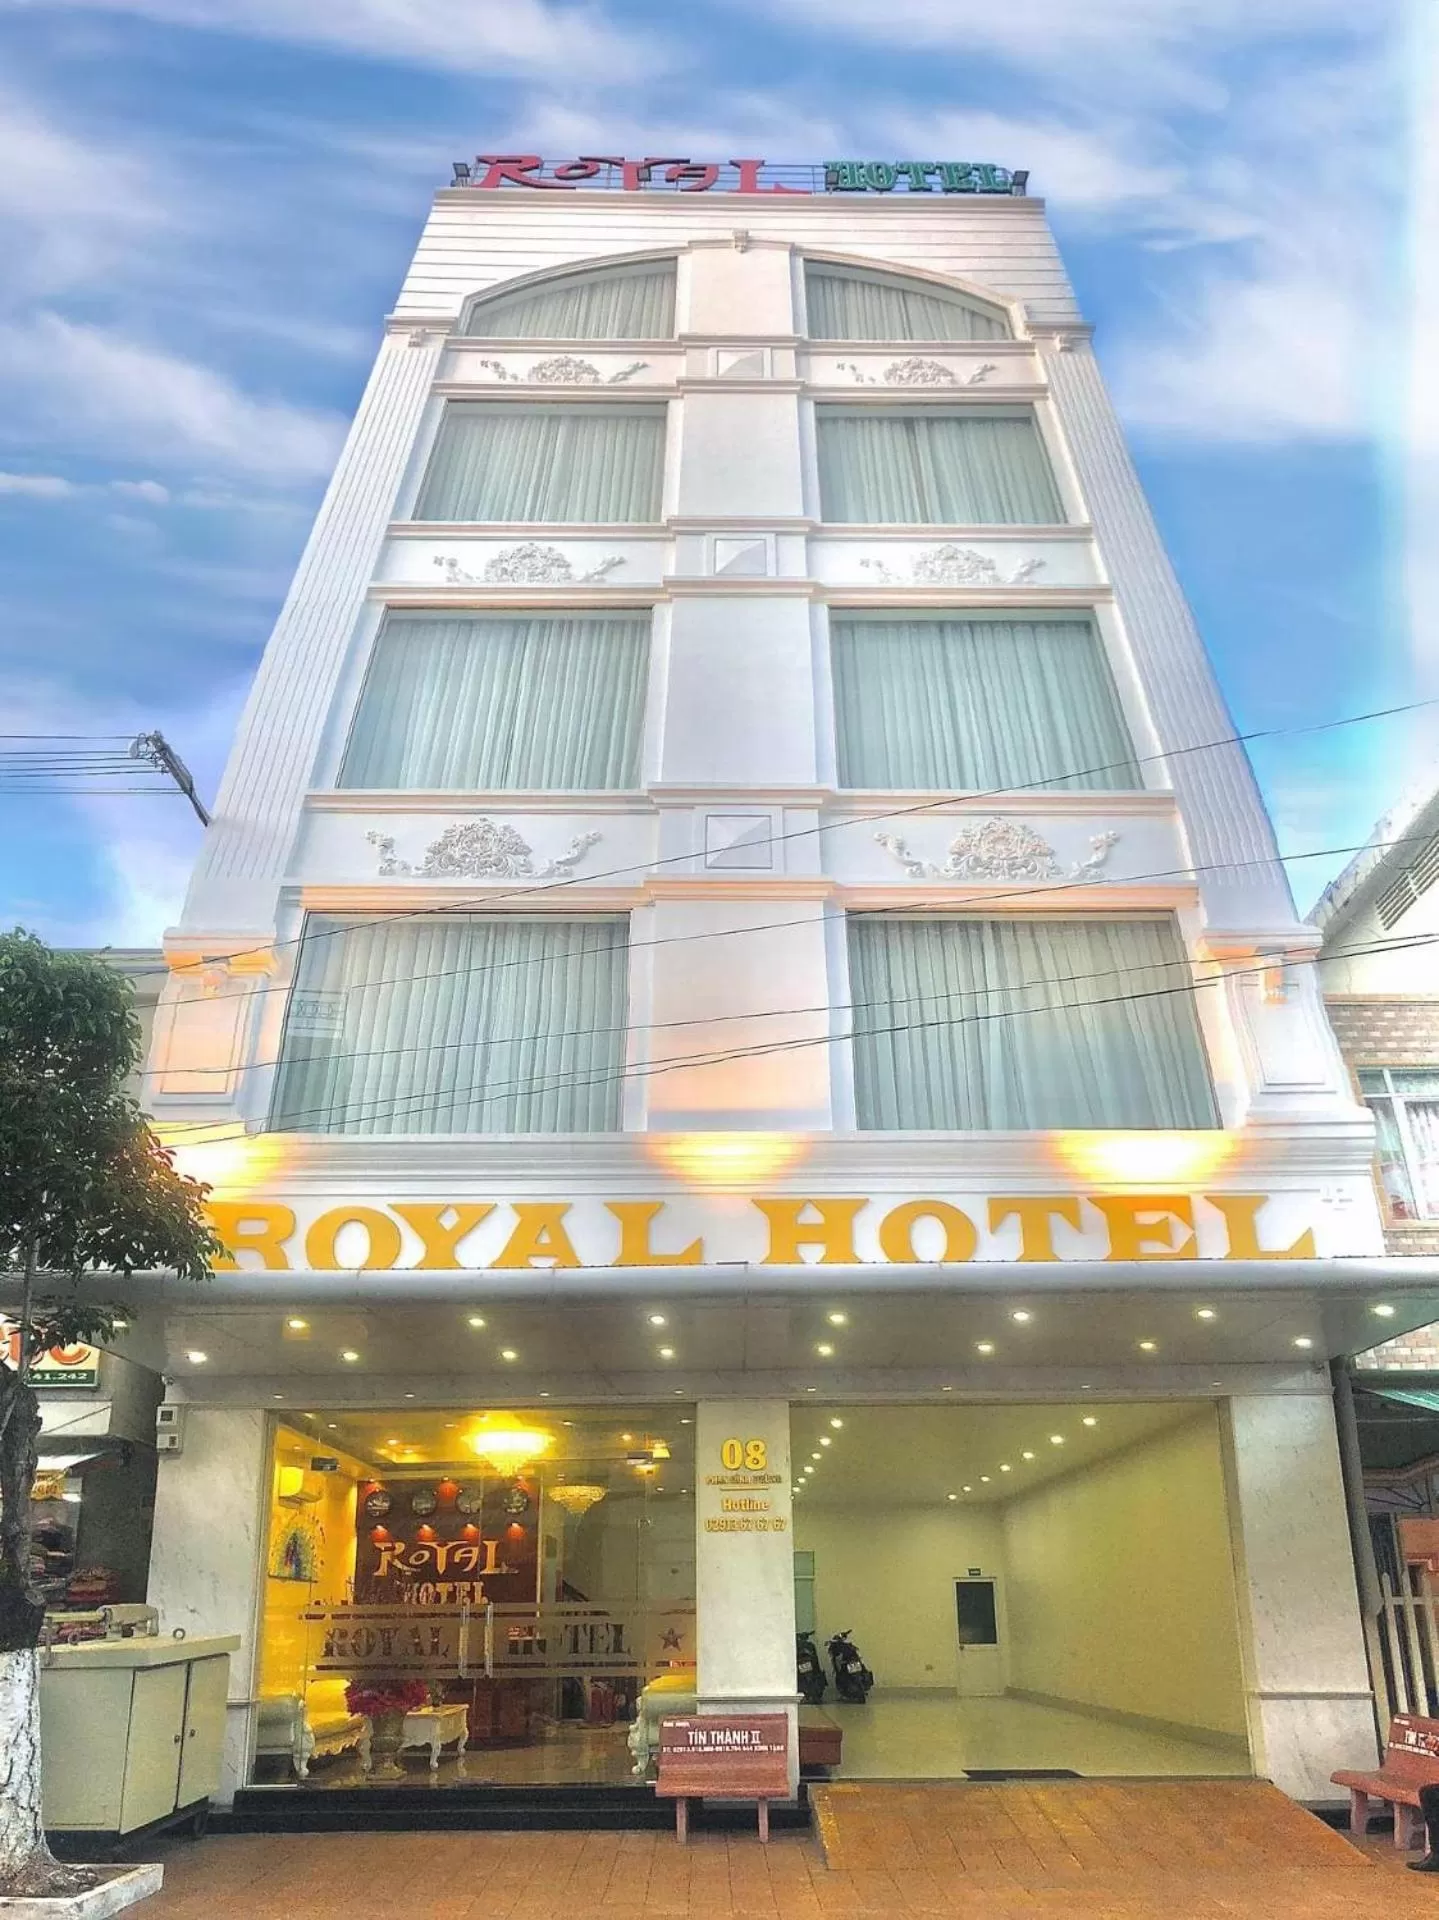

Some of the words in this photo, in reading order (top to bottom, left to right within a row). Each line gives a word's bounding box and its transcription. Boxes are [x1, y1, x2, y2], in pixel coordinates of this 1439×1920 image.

[823, 161, 1014, 192] HOTEL
[202, 1202, 704, 1270] ROYAL
[752, 1195, 1316, 1264] HOTEL
[722, 1439, 767, 1471] 08
[722, 1498, 769, 1511] Hotline
[403, 1581, 490, 1606] HOTEL
[321, 1626, 450, 1658] ROYAL
